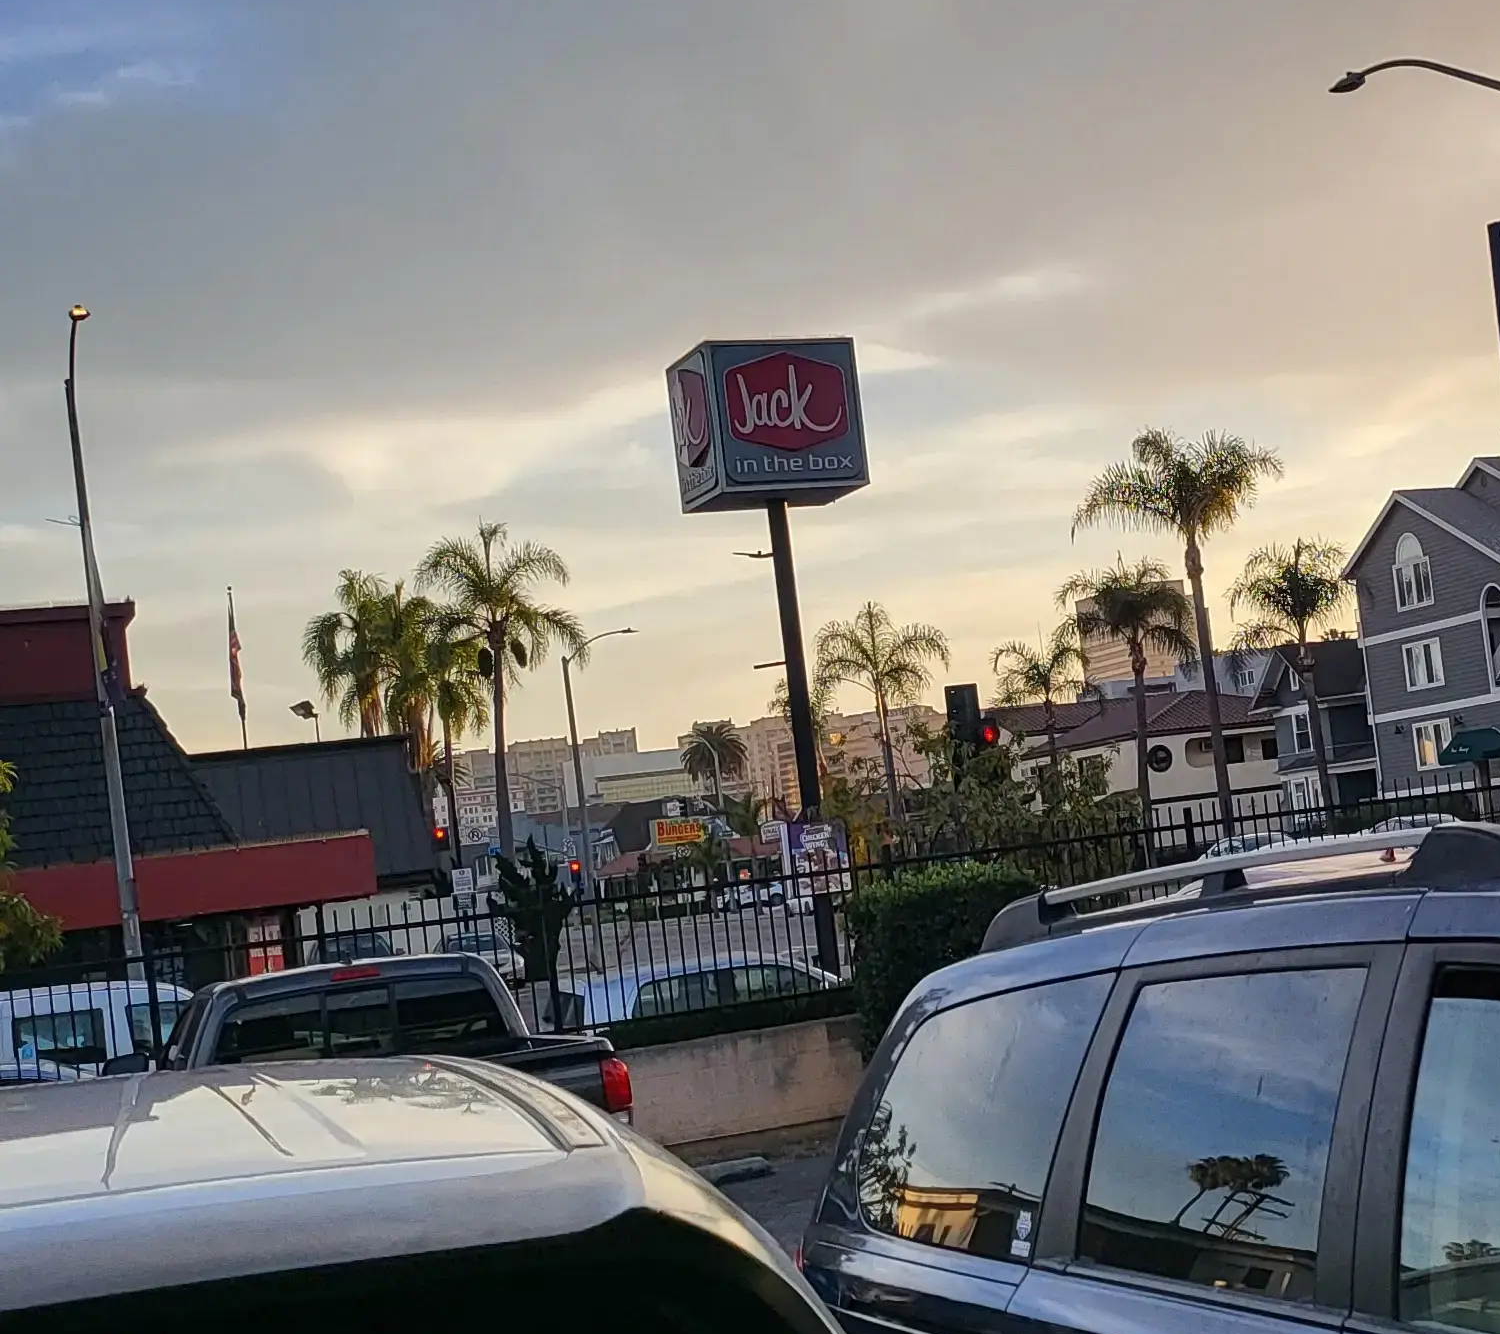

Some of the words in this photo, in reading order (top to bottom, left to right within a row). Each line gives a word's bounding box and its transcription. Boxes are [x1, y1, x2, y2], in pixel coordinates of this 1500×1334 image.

[734, 365, 842, 434] Jack
[736, 456, 757, 473] in
[763, 455, 803, 472] the
[809, 453, 853, 471] box
